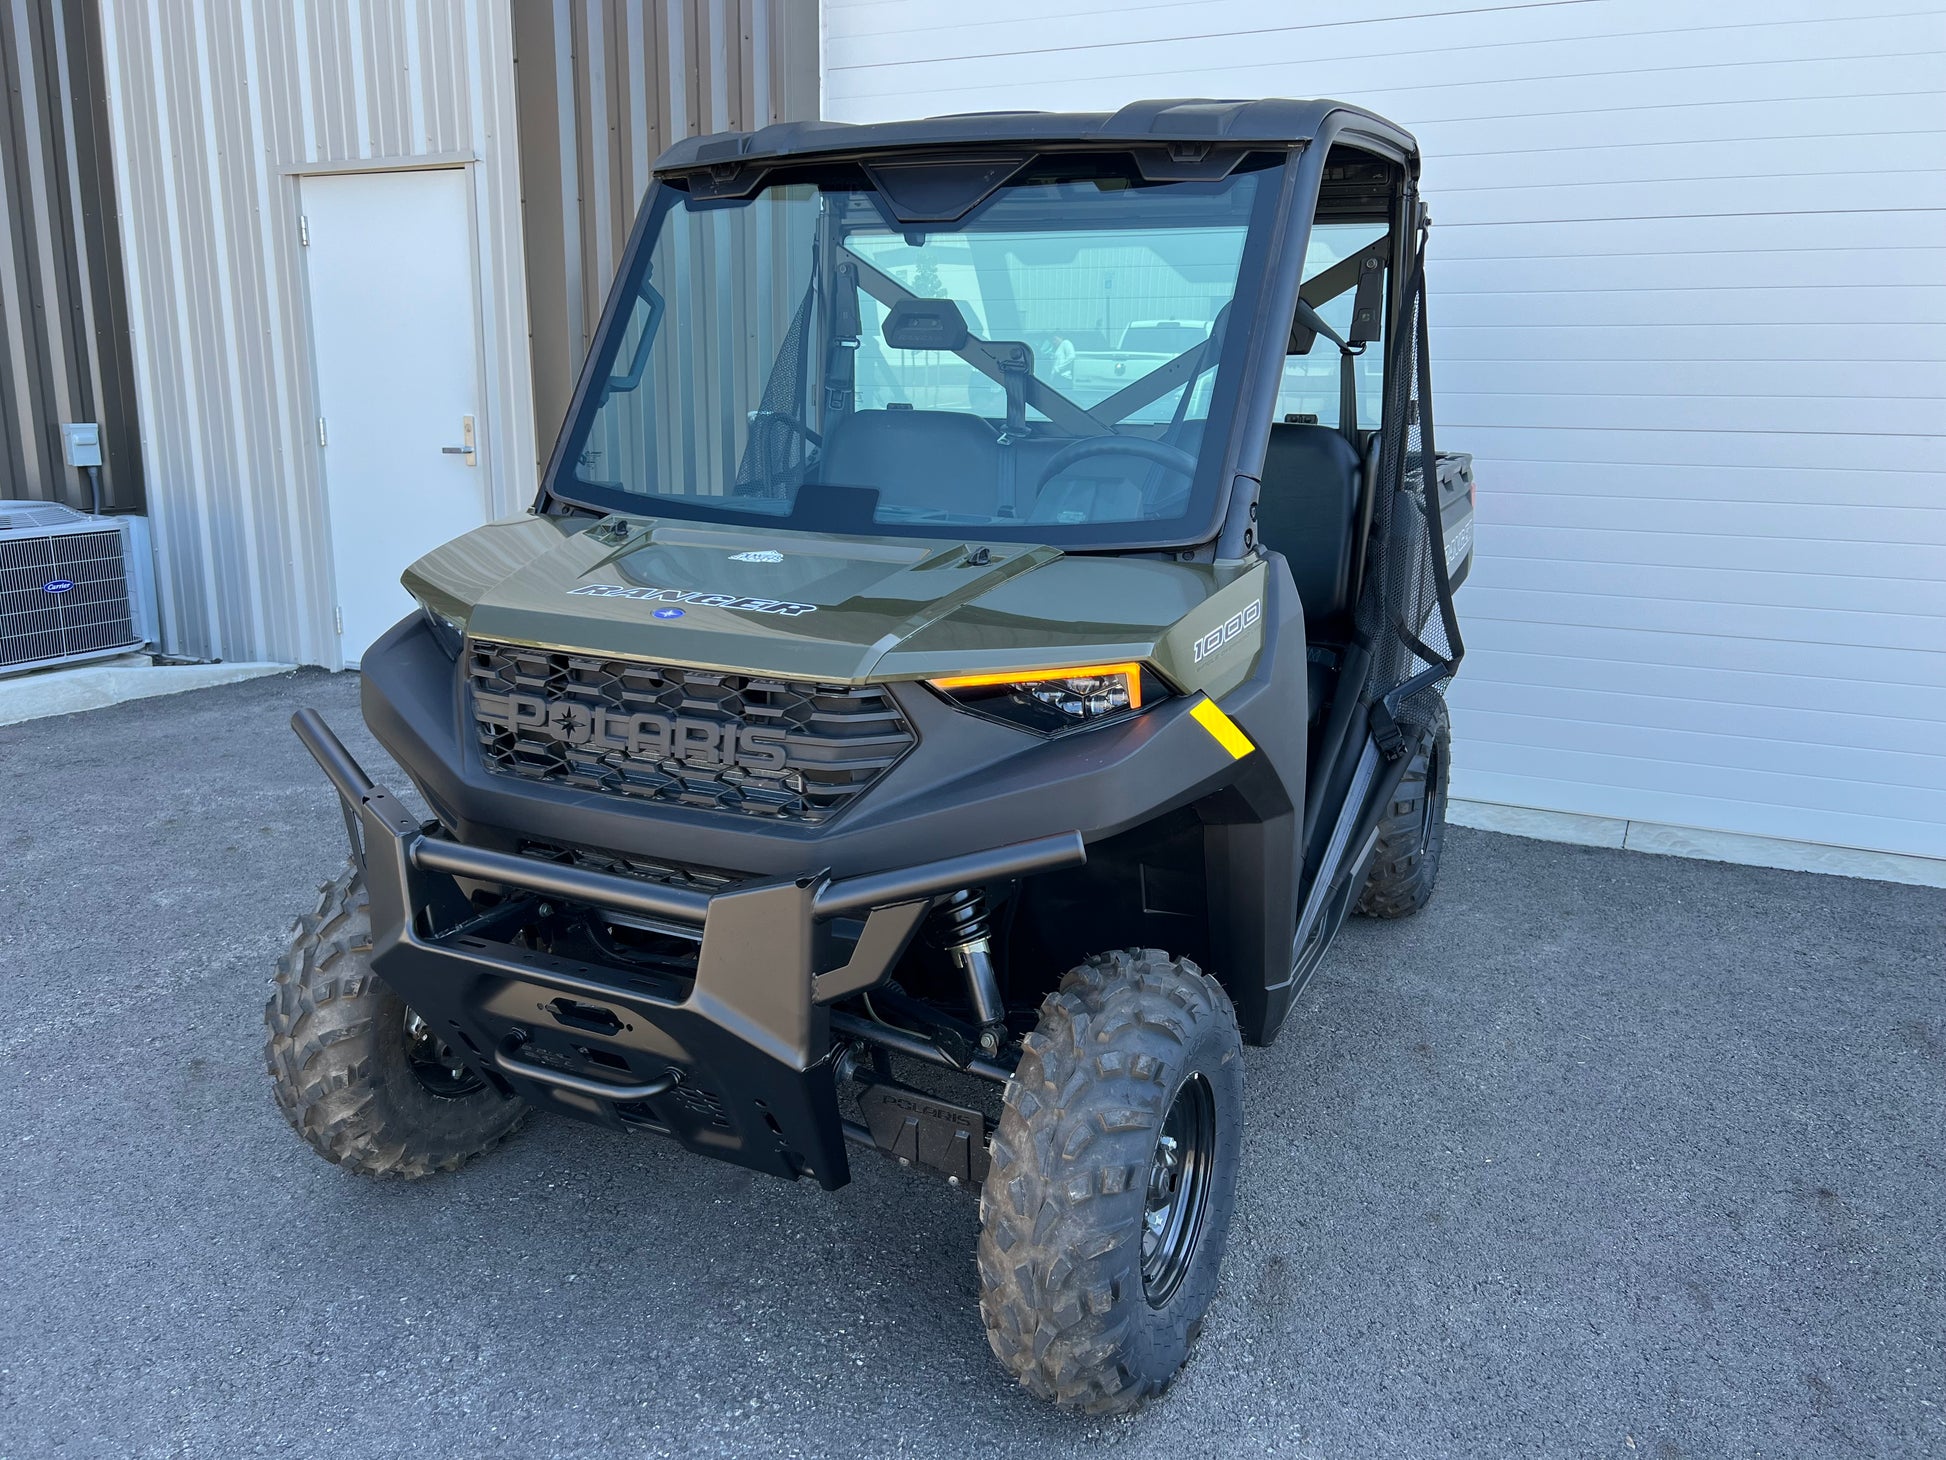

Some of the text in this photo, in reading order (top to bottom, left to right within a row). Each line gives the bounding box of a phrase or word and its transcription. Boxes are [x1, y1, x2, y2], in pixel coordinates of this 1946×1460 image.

[47, 583, 71, 591] Carrier
[566, 584, 818, 616] RANGER
[1193, 598, 1261, 664] 1000
[508, 692, 788, 771] POLARIS
[882, 1095, 971, 1127] POLARIS
